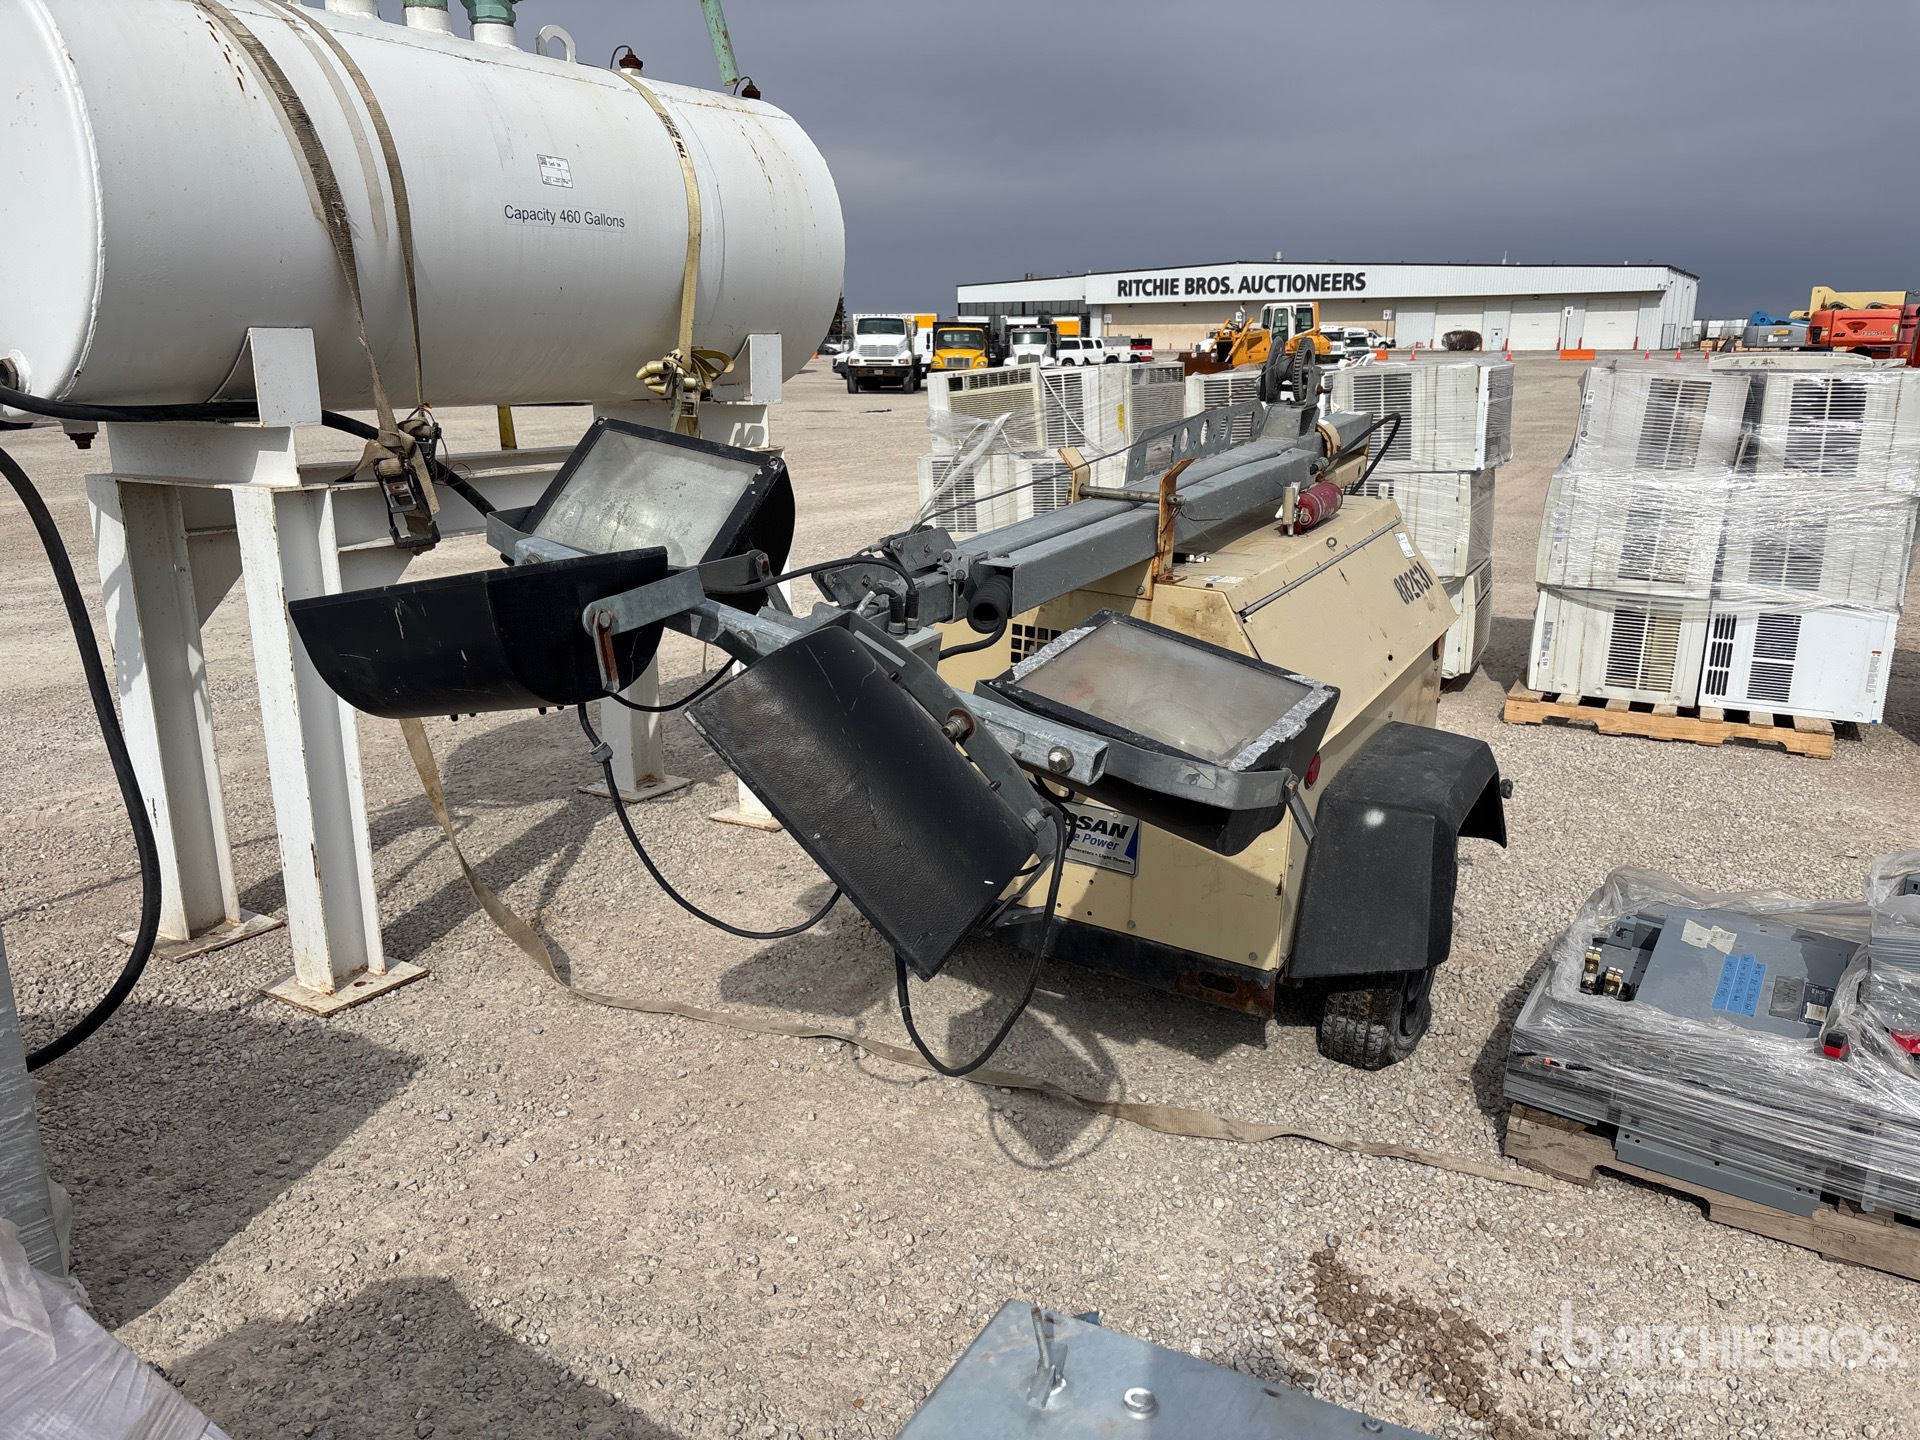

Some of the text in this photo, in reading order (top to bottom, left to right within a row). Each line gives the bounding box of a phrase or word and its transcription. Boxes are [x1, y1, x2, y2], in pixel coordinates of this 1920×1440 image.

[675, 140, 687, 159] WLL
[504, 204, 625, 228] Capacity 460 Gallons
[1117, 272, 1366, 297] RITCHIE BROS. AUCTIONEERS
[1082, 833, 1120, 851] Power
[1098, 853, 1112, 861] Light
[1112, 857, 1131, 865] Towers
